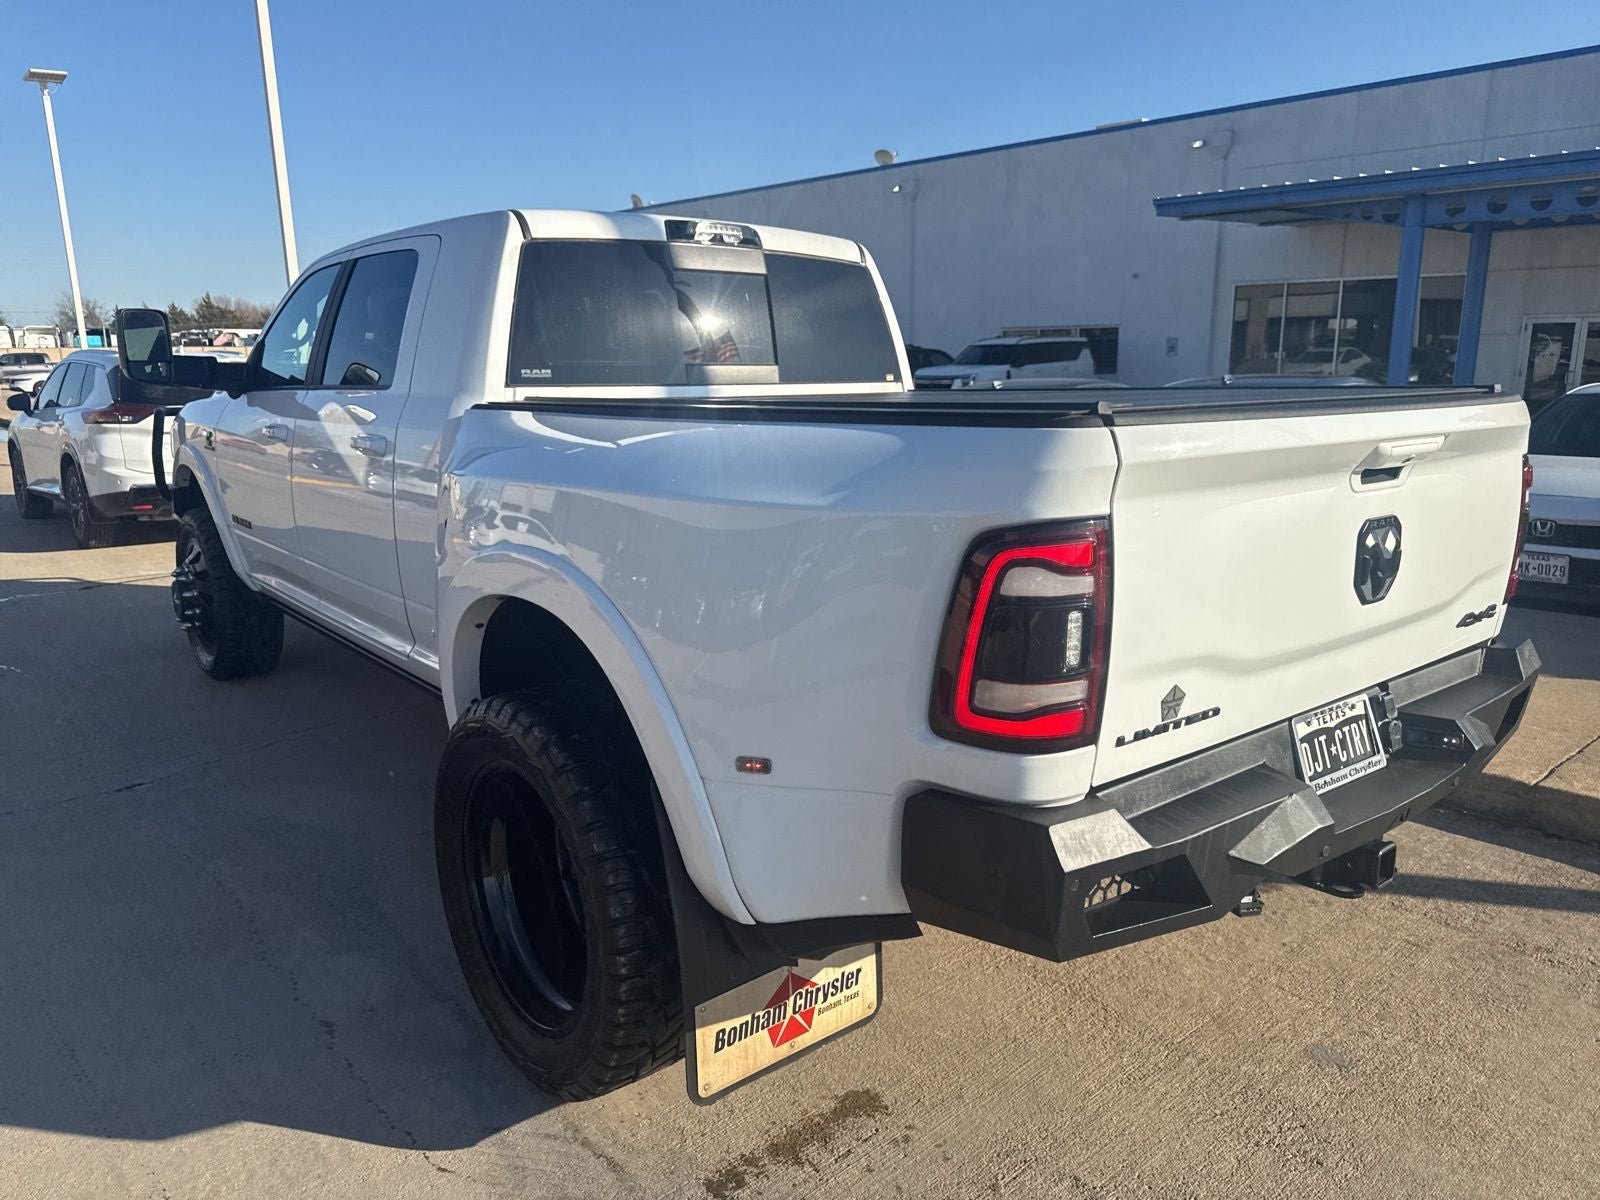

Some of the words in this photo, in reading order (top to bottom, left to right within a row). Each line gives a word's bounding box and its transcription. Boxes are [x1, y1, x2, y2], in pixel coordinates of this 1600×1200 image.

[1370, 517, 1395, 529] RAM
[1527, 553, 1551, 561] TEXAS
[1537, 562, 1566, 578] 0029
[1315, 709, 1346, 726] TEXAS
[1114, 706, 1221, 748] LIMITED
[1314, 773, 1348, 790] Bonham
[1349, 759, 1382, 776] Chrysler
[843, 990, 860, 1003] Texas
[713, 1000, 788, 1054] Bonham
[791, 966, 862, 1016] Chrysler
